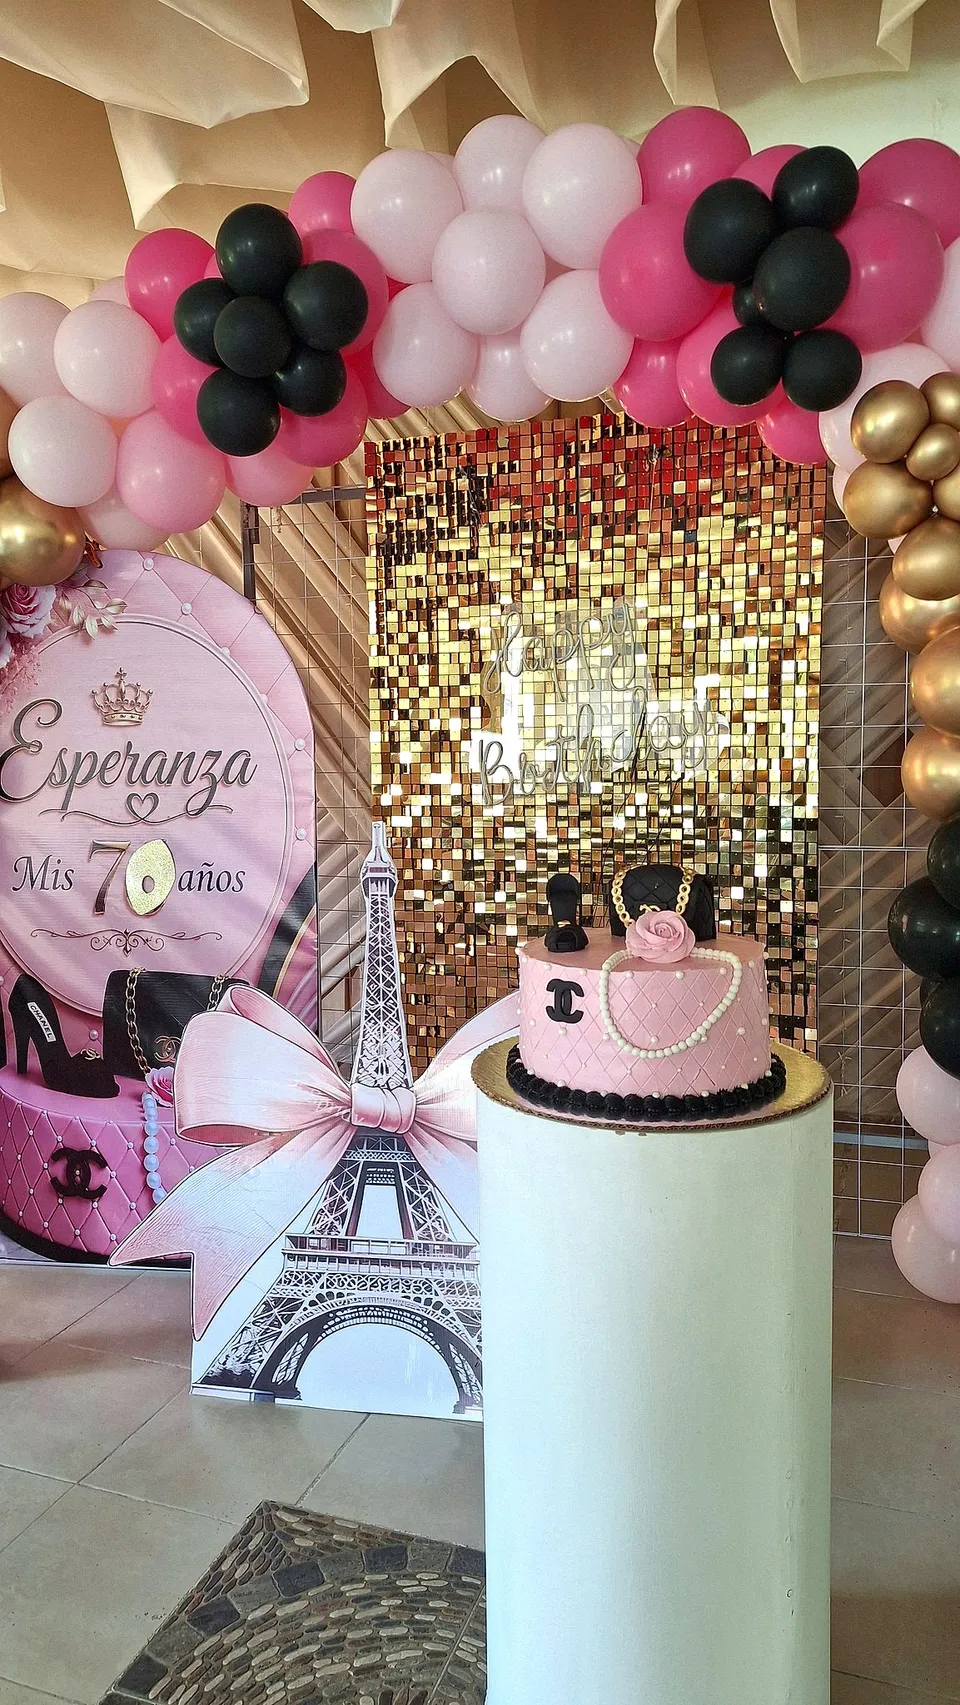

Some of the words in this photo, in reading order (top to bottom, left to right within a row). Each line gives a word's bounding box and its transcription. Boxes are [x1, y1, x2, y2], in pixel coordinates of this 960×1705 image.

[484, 603, 636, 703] Happy
[0, 698, 258, 817] Esperanza
[12, 855, 75, 892] Mis
[87, 838, 177, 916] 70
[177, 862, 245, 894] años
[29, 1004, 53, 1040] CHANEL
